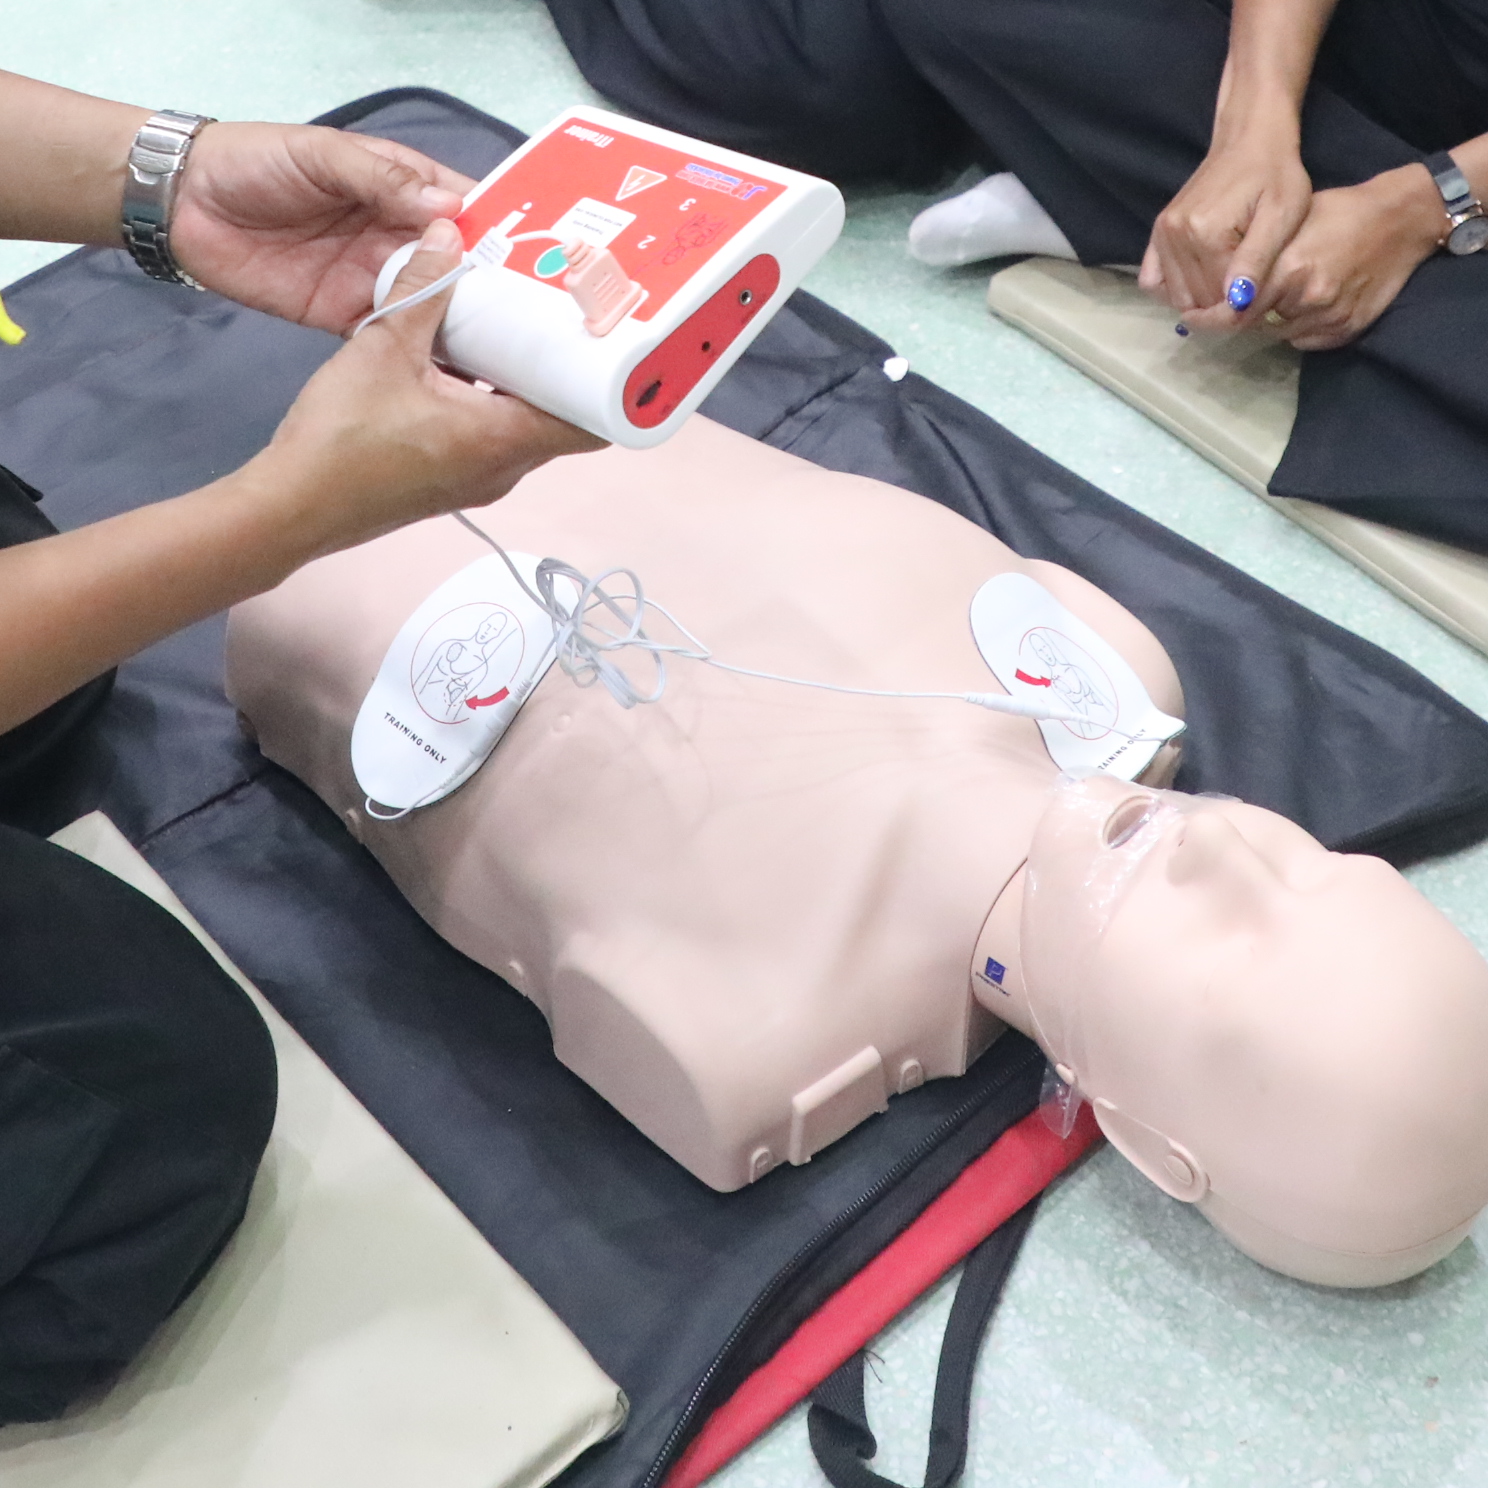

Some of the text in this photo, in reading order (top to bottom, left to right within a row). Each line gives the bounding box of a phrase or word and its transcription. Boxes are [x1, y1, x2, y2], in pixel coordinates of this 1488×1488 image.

[678, 197, 697, 212] 3
[637, 234, 657, 250] 2
[383, 712, 447, 764] TRAINING ONLY
[1097, 745, 1128, 770] RAINING
